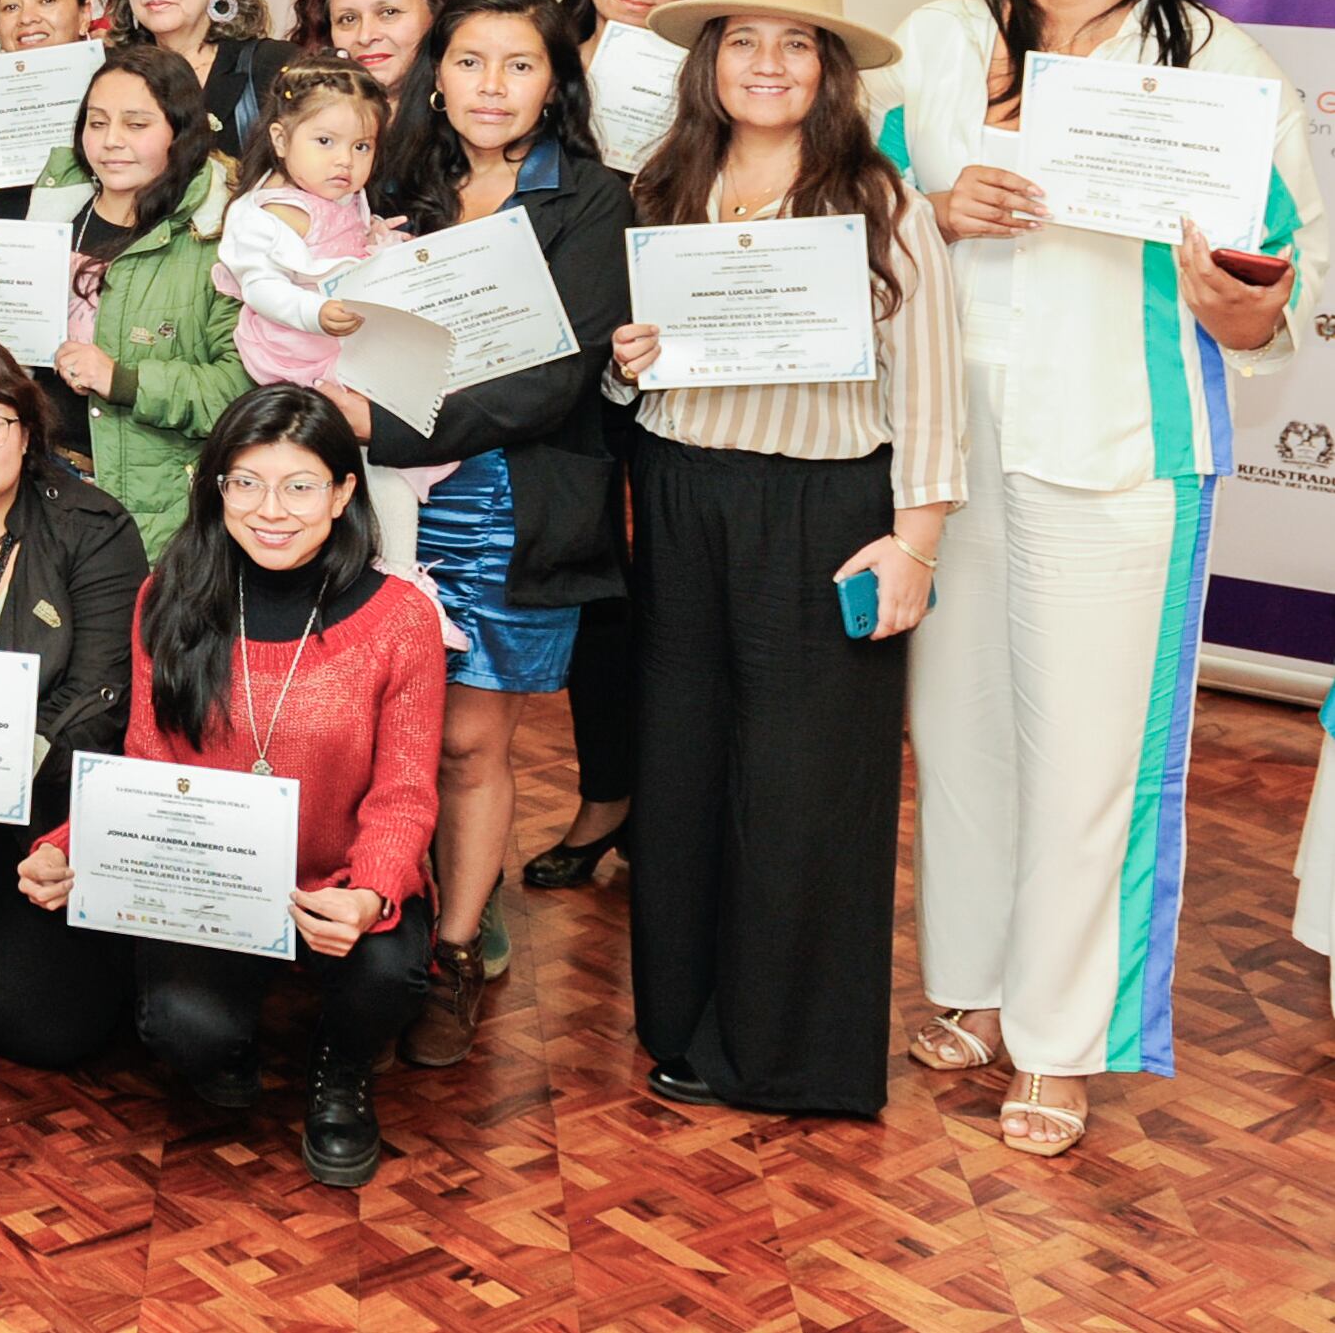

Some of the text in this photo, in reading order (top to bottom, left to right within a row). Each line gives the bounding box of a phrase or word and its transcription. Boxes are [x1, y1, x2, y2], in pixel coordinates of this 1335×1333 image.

[1096, 131, 1141, 143] MARINELA
[691, 290, 726, 298] AMANDA
[107, 829, 139, 841] JOHANA
[140, 834, 189, 847] ALEXANDRA
[190, 840, 224, 852] ARMERO
[100, 862, 130, 873] POLÍTICA
[131, 867, 148, 876] PARA
[149, 869, 180, 881] MUJERES
[193, 876, 210, 886] TODA
[222, 881, 263, 893] DIVERSIDAD
[120, 857, 130, 865] EN
[131, 859, 159, 869] PARIDAD
[161, 862, 191, 873] ESCUELA
[202, 868, 243, 881] FORMACIÓN
